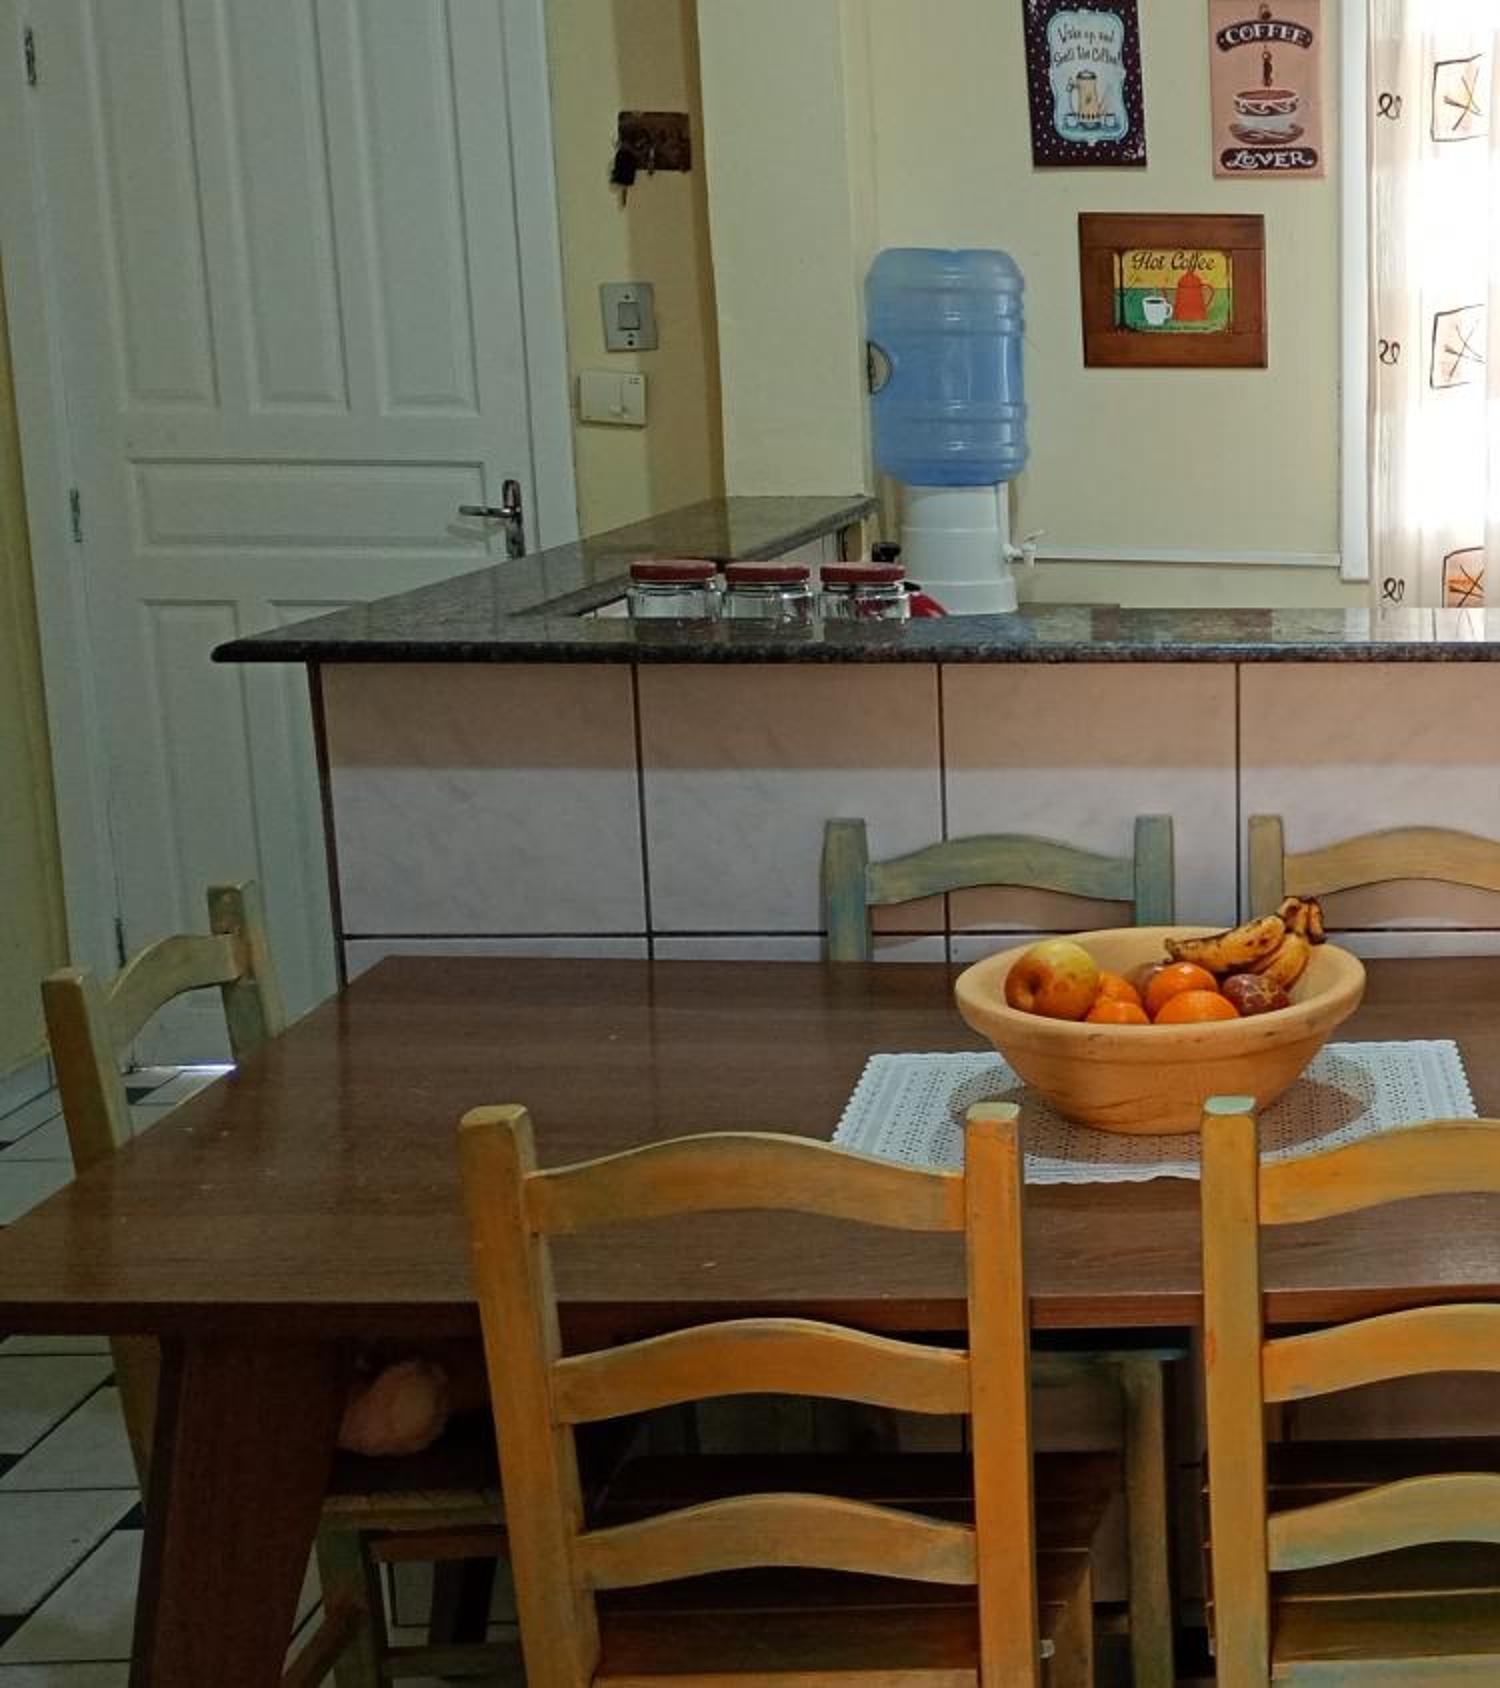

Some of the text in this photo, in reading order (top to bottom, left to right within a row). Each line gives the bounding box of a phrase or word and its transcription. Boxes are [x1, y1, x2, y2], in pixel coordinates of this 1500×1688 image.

[1225, 23, 1307, 43] COFFEE
[1226, 151, 1314, 169] LOVER
[1131, 251, 1215, 272] Hot Coffee
